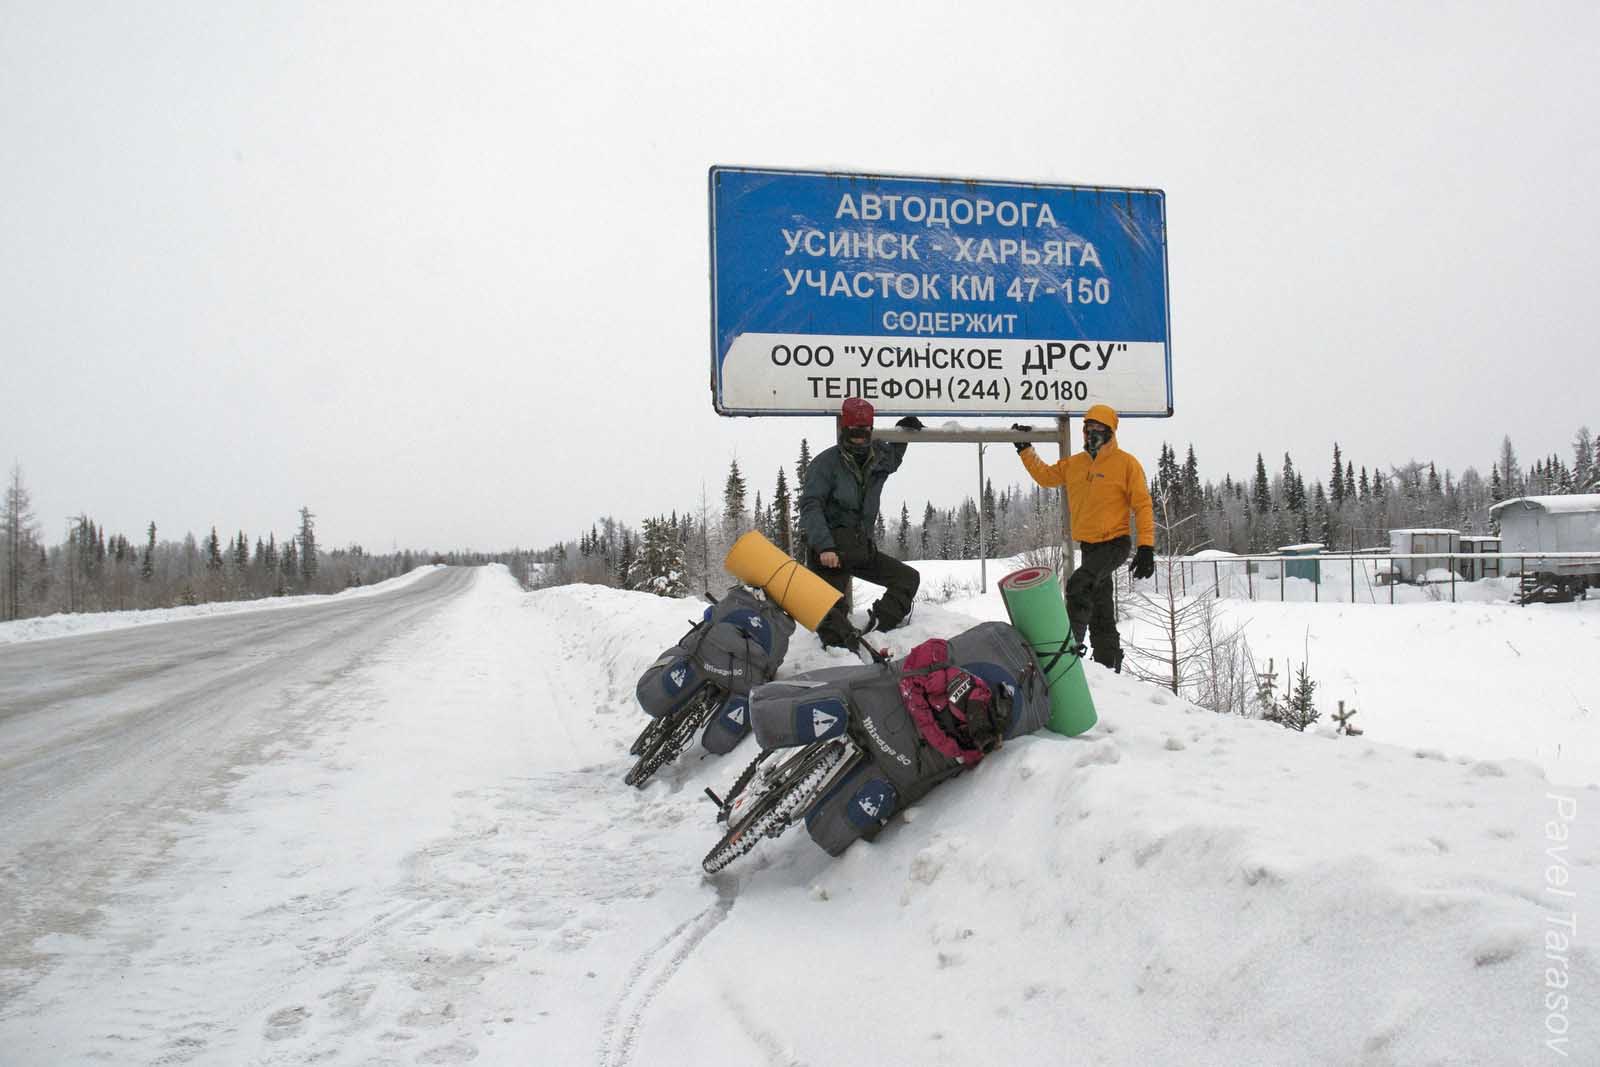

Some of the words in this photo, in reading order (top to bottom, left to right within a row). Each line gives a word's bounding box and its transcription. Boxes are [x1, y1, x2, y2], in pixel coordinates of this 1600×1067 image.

[835, 193, 1057, 229] АВТОДОРОГА
[782, 229, 920, 260] УСИНСК
[952, 236, 1101, 268] ХАРЬЯГА
[783, 269, 940, 300] УЧАСТОК
[951, 274, 995, 302] КМ
[883, 310, 1018, 335] СОДЕРЖИТ
[771, 344, 834, 367] ООО
[844, 345, 1003, 370] "УСИНСКОЕ
[1022, 342, 1128, 375] ДРСУ"
[807, 376, 942, 400] ТЕЛЕФОН
[947, 376, 1011, 403] (244)
[1020, 380, 1088, 401] 20180
